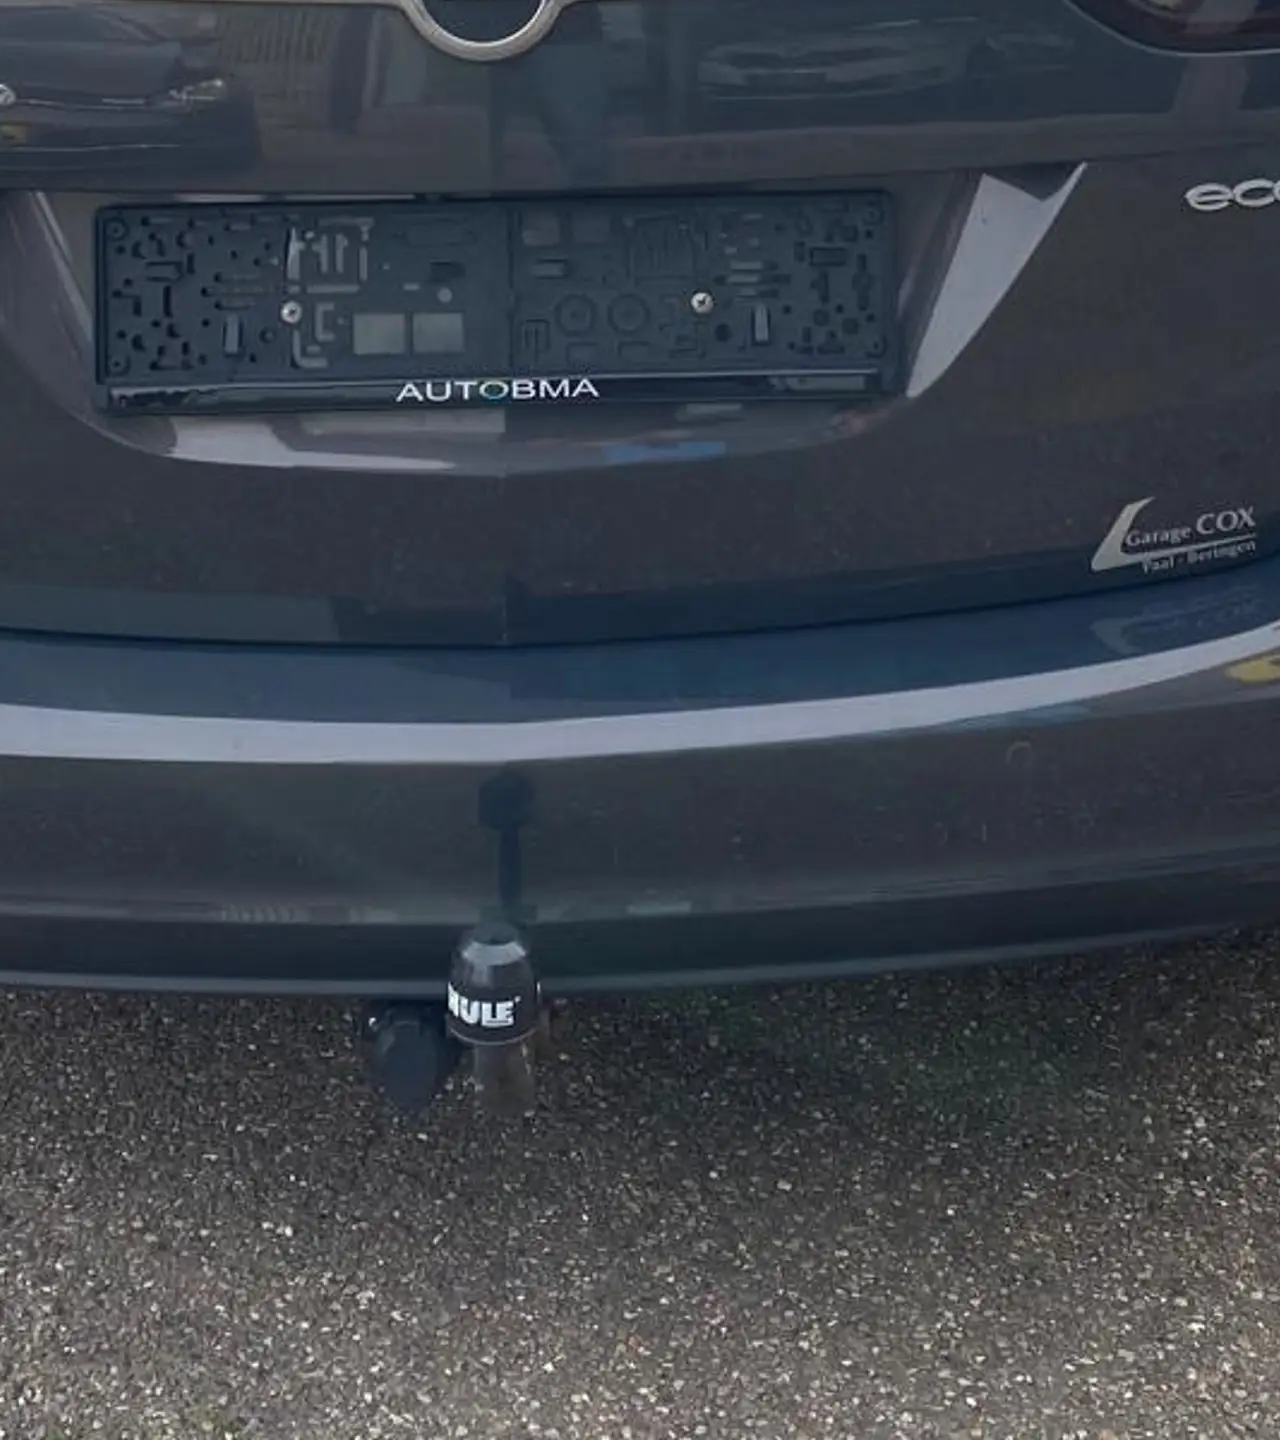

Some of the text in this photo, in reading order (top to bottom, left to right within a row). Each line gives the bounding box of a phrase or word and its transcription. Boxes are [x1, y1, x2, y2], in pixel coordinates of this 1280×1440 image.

[395, 378, 599, 402] AUTOBMA
[1126, 506, 1256, 548] Garage COX
